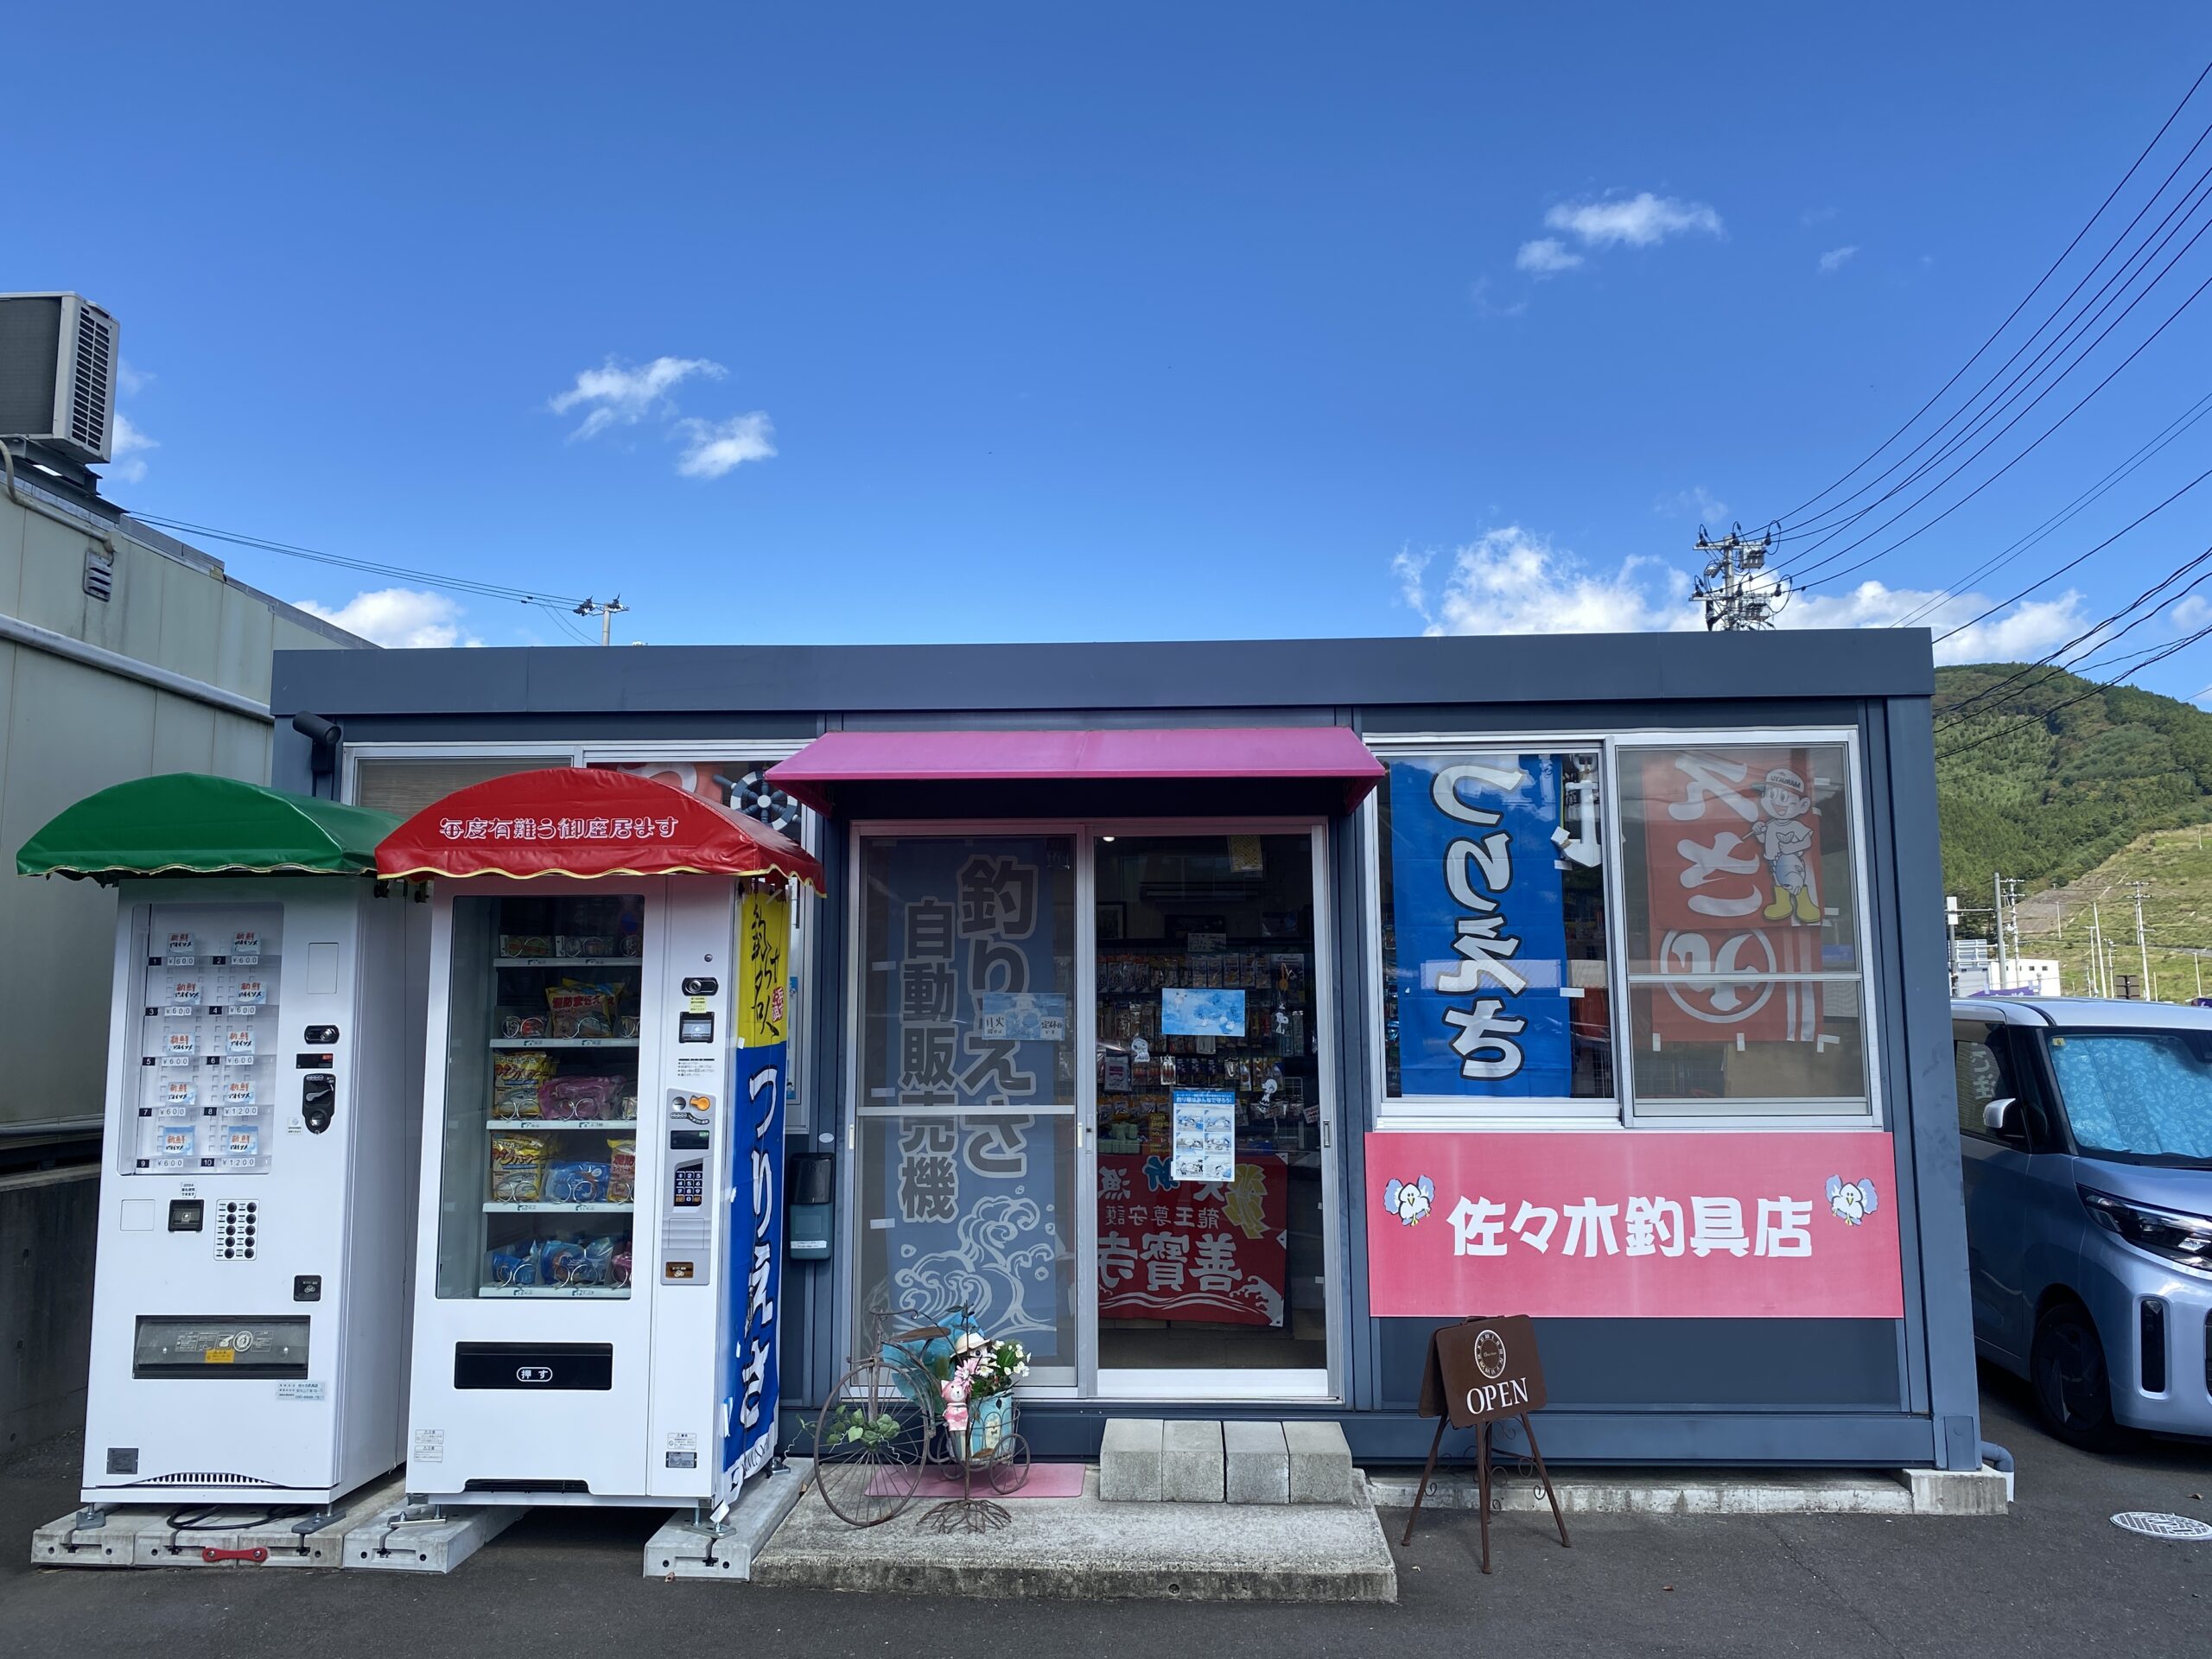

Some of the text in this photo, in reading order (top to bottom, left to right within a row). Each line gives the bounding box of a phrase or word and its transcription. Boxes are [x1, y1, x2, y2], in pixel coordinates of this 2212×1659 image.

[900, 896, 959, 1224] 自動販売機
[1446, 1195, 1814, 1258] 佐々木釣具店
[521, 1370, 548, 1379] 押す
[1466, 1377, 1529, 1414] OPEN
